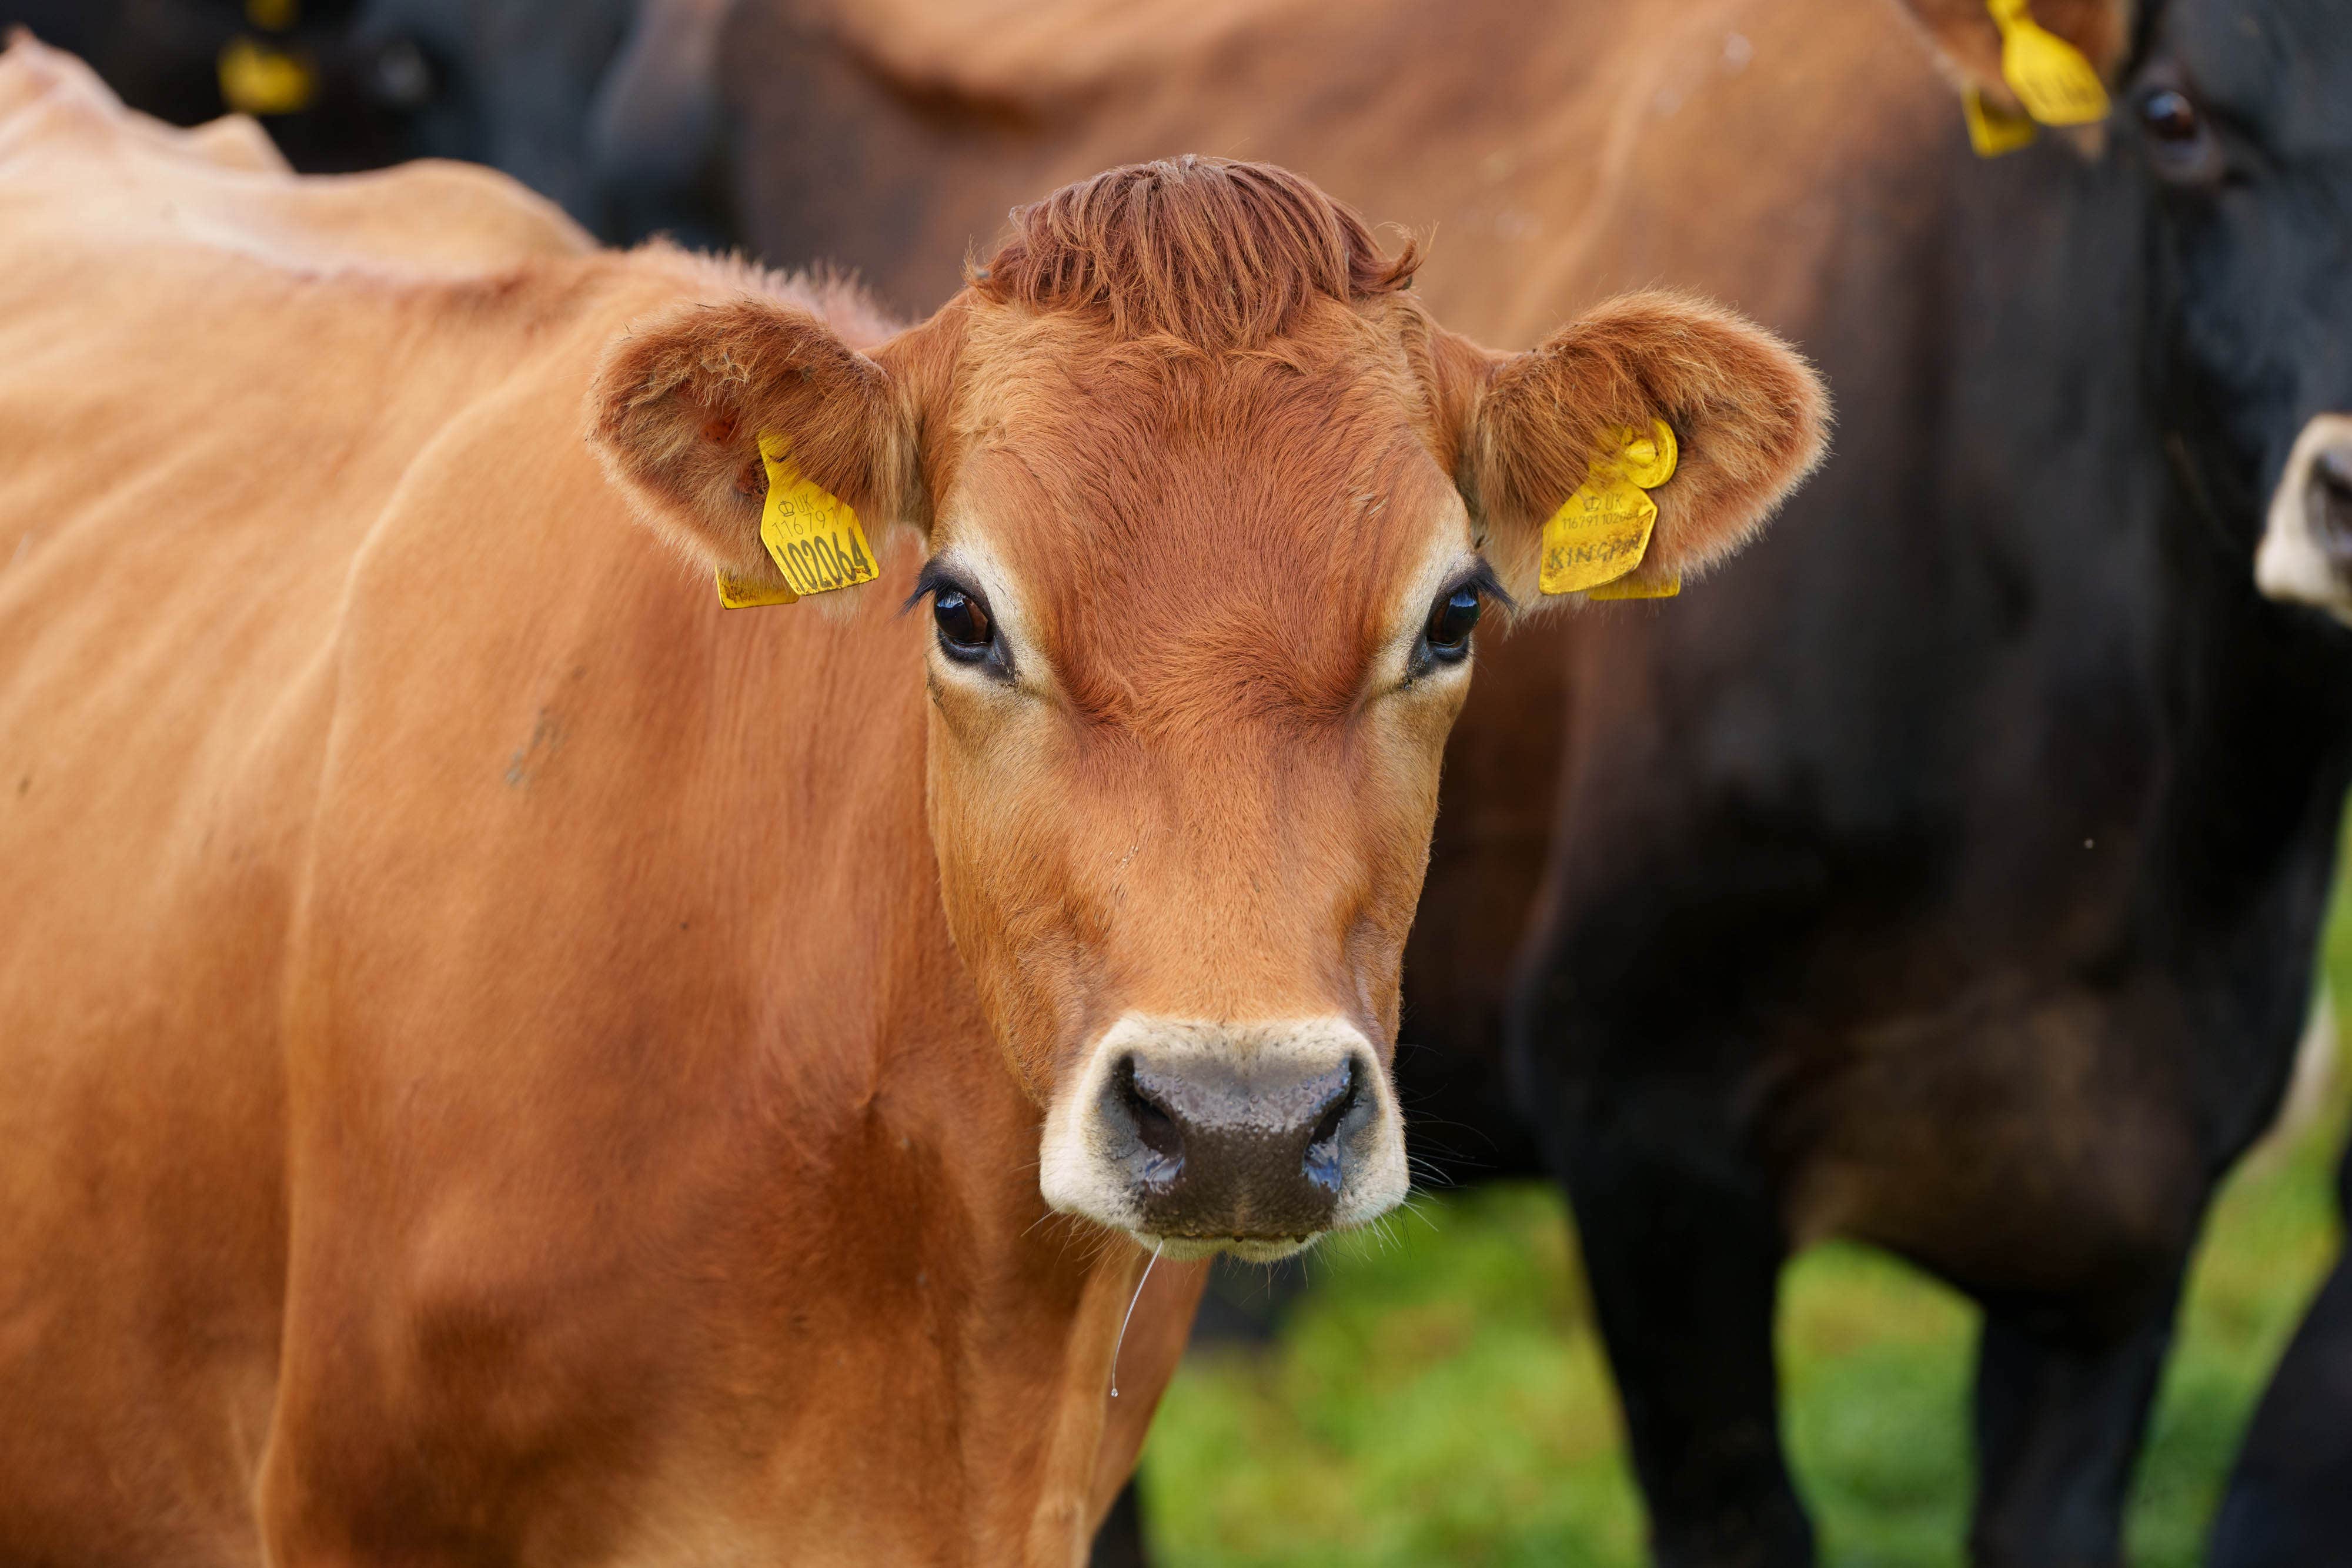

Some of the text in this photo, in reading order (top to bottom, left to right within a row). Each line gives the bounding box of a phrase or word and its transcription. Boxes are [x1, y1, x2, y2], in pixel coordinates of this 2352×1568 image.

[794, 494, 814, 513] UK
[1605, 493, 1623, 510] UK
[771, 506, 839, 539] 116791
[776, 527, 872, 591] 102064
